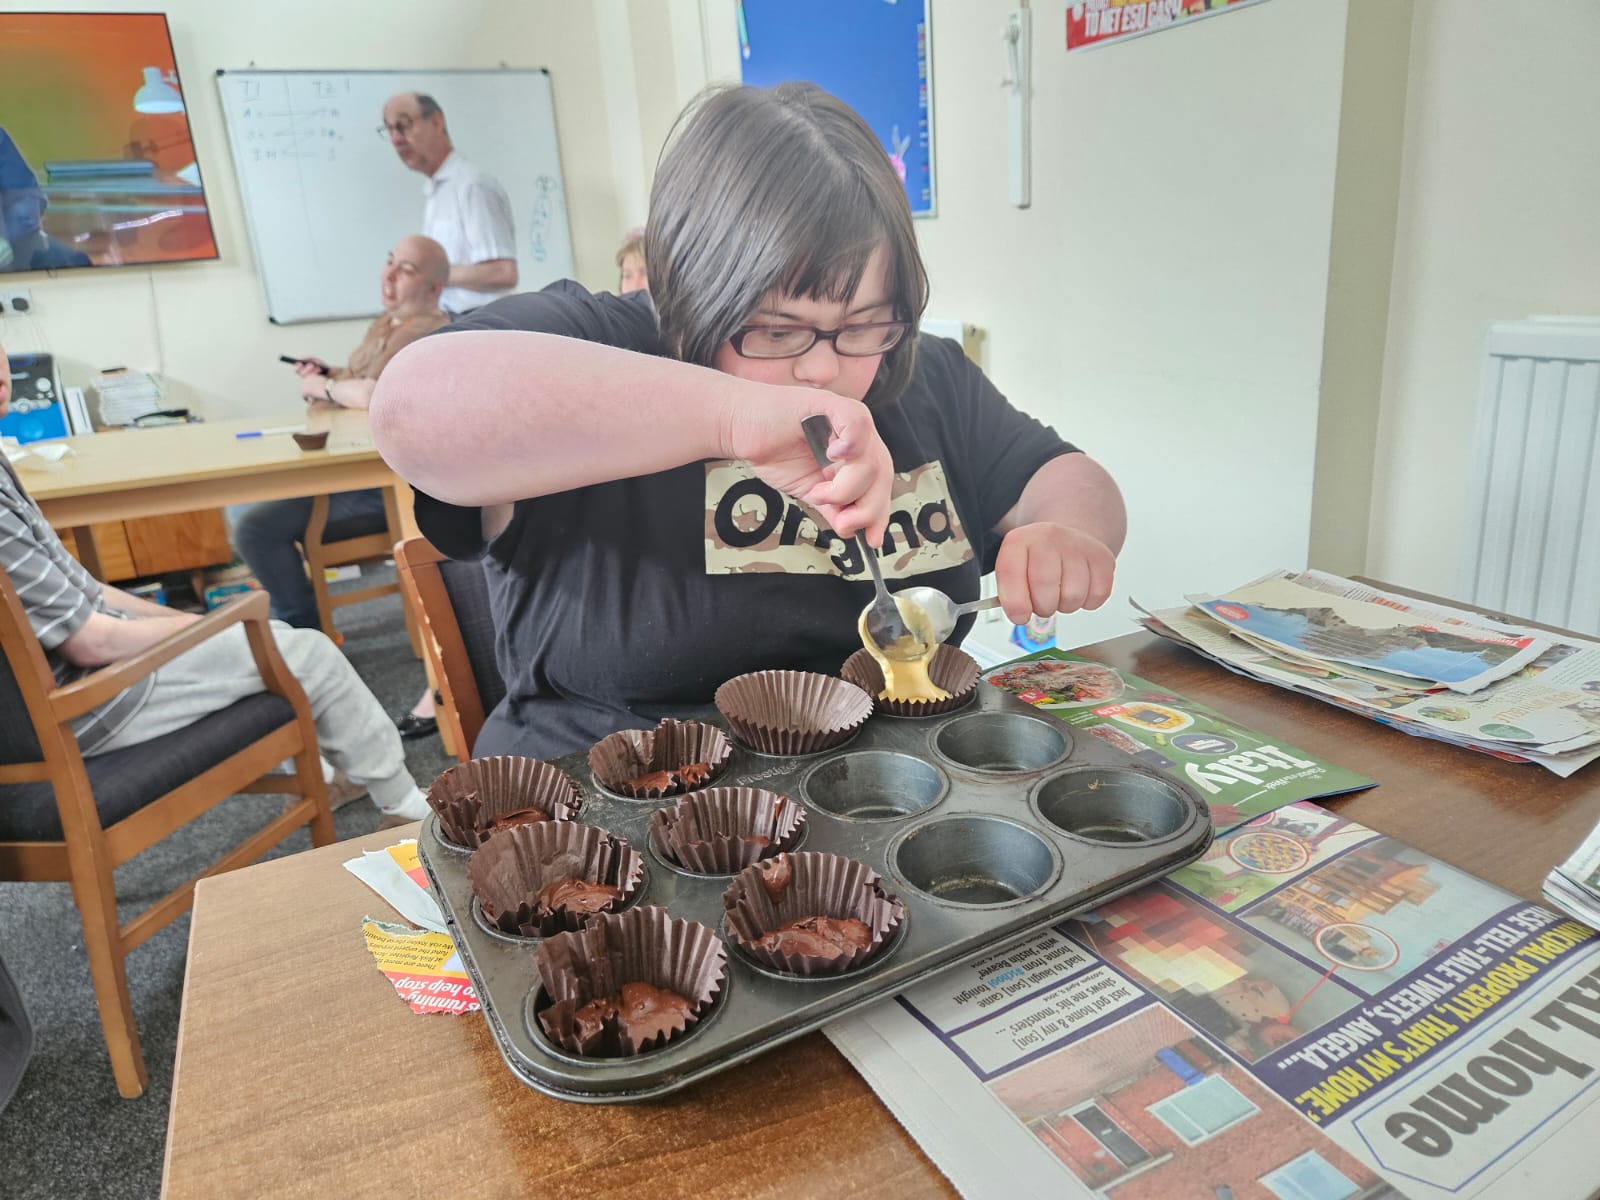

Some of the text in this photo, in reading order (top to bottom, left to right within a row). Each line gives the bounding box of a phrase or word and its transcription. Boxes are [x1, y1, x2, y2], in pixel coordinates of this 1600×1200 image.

[1099, 7, 1122, 35] NET
[1184, 744, 1317, 795] Italy
[1036, 937, 1060, 951] with
[1043, 945, 1074, 961] home
[1434, 923, 1529, 984] TELL-TALE
[1021, 957, 1048, 972] from
[394, 976, 428, 989] stop
[428, 979, 463, 997] help
[976, 954, 1087, 1008] had to laugh [son] came
[1086, 977, 1117, 996] shows
[1433, 956, 1540, 1024] PROPERTY,
[407, 991, 467, 1011] running
[953, 984, 991, 1005] tonight
[1056, 998, 1076, 1010] his
[1070, 989, 1089, 1002] me
[1362, 973, 1456, 1026] TWEETS,
[1012, 987, 1132, 1051] Just got home & my [son]
[1382, 1014, 1459, 1064] THAT'S
[1356, 1048, 1402, 1083] MY
[1385, 1027, 1595, 1158] home
